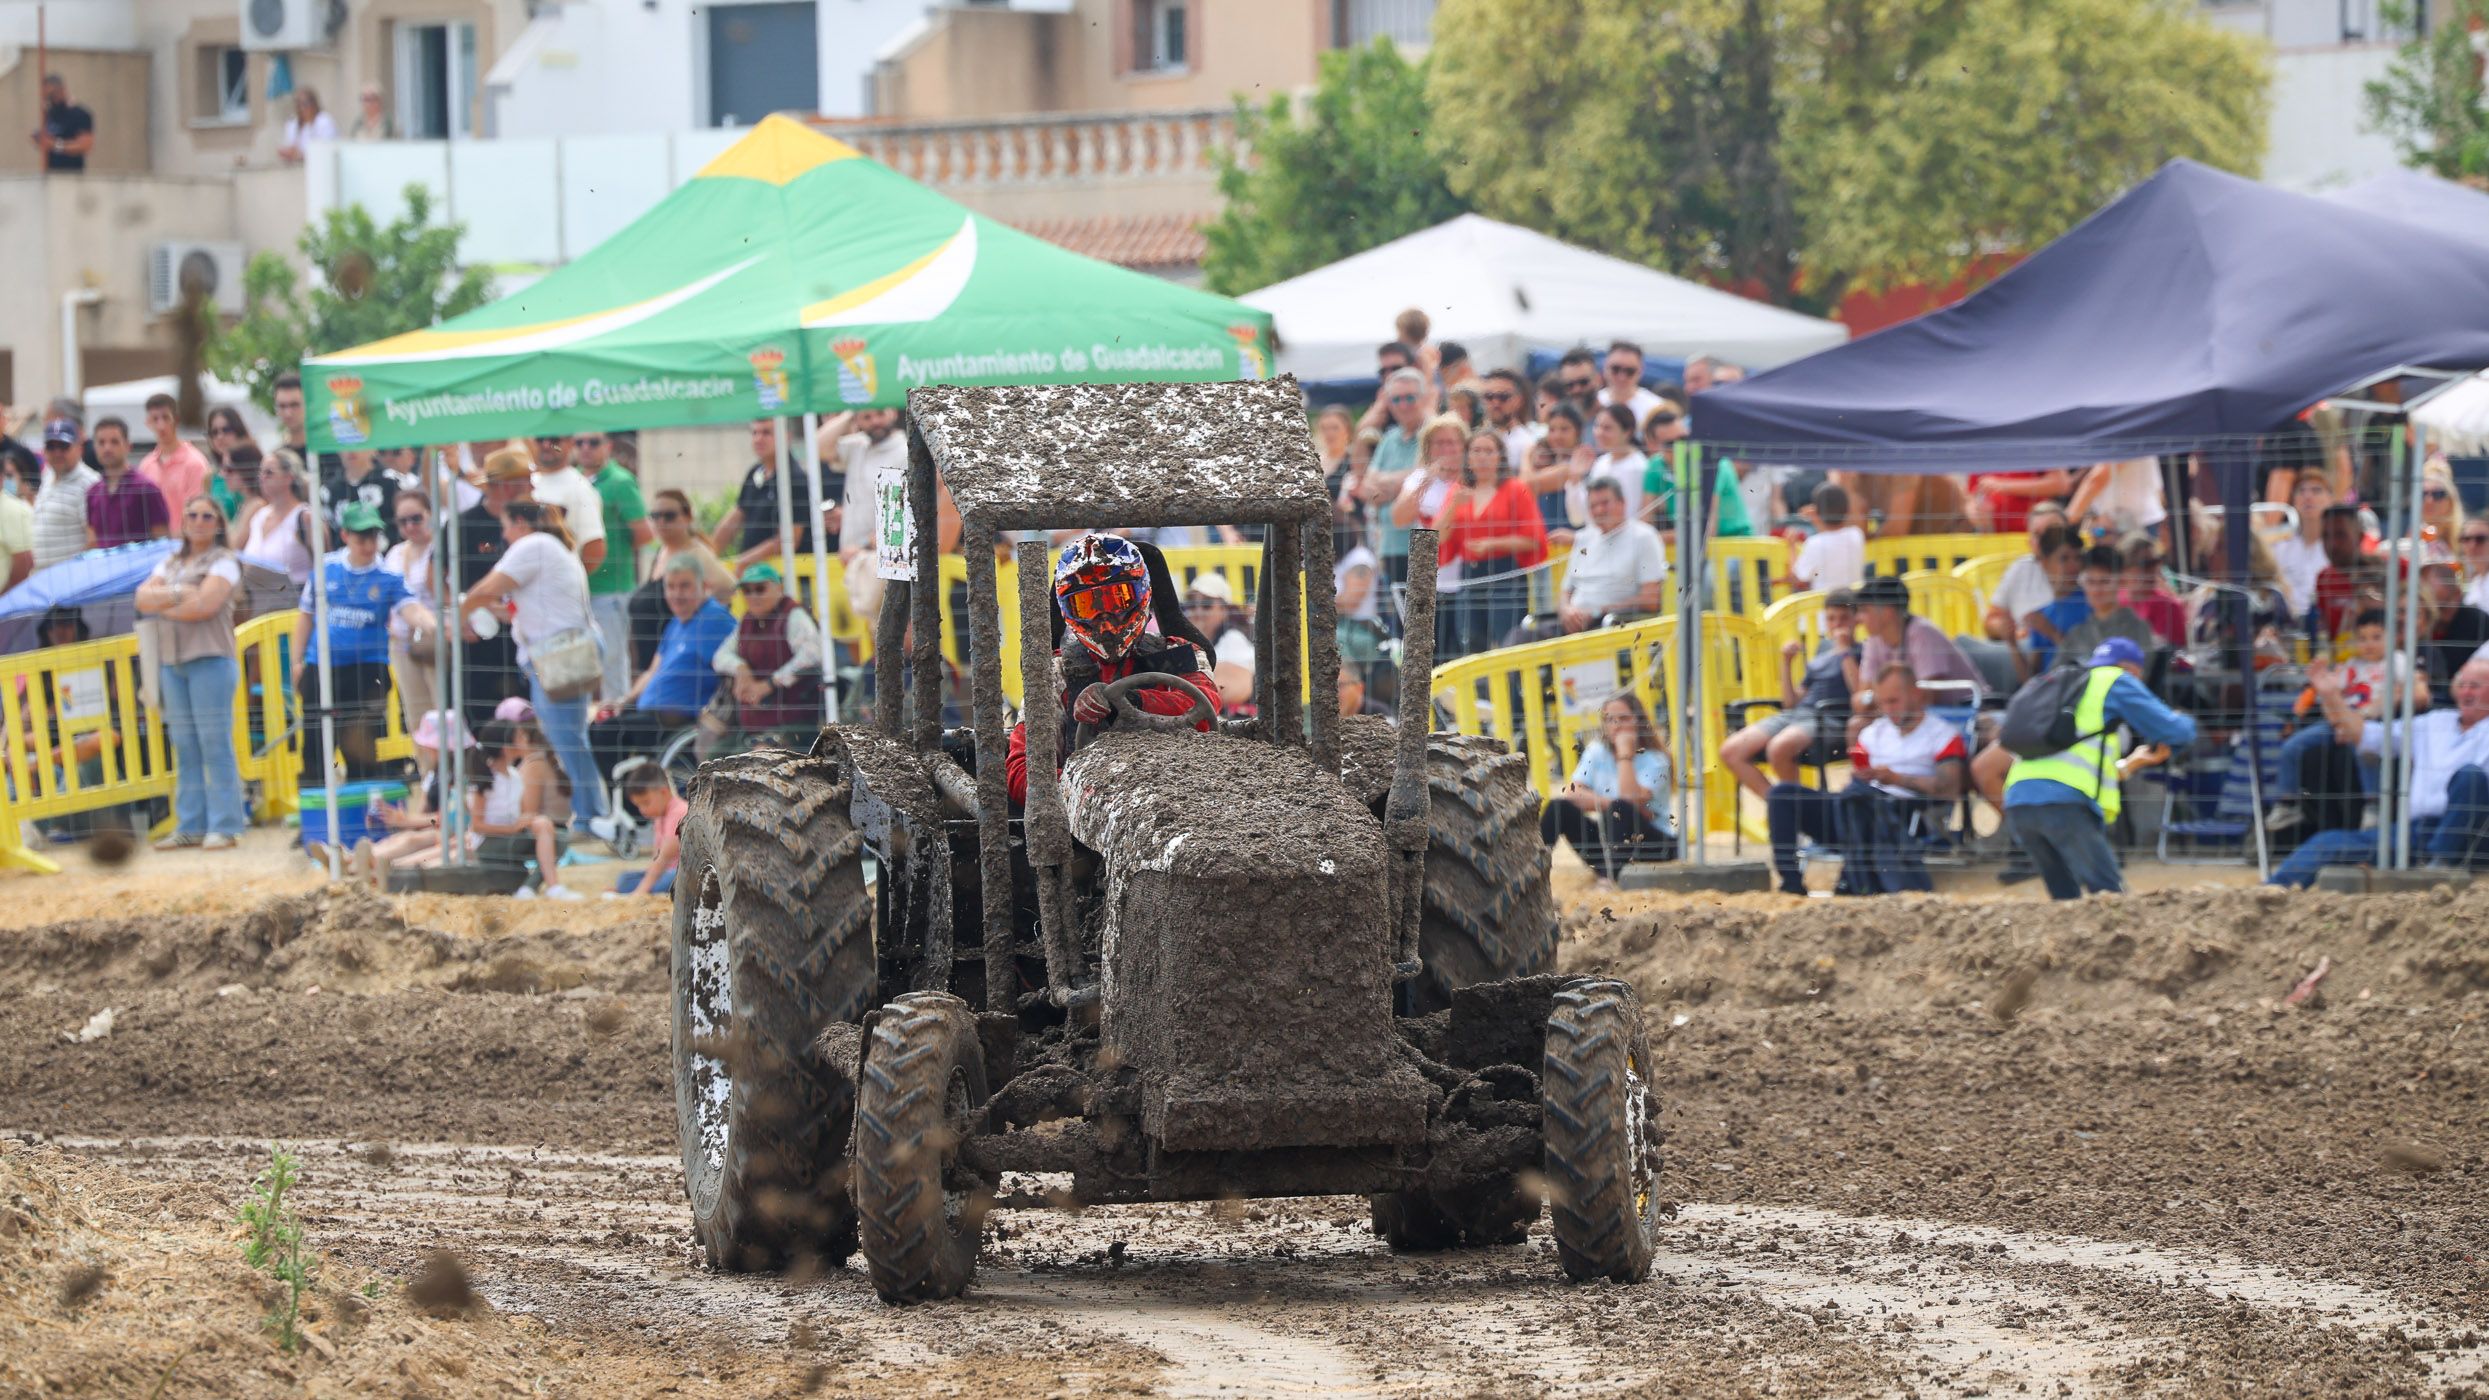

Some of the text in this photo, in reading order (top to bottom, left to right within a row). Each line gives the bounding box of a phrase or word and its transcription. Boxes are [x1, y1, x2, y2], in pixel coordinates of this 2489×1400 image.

[896, 347, 1057, 385] Ayuntamiento
[1060, 345, 1089, 372] de
[384, 384, 544, 426] Ayuntamiento
[547, 380, 578, 410] de
